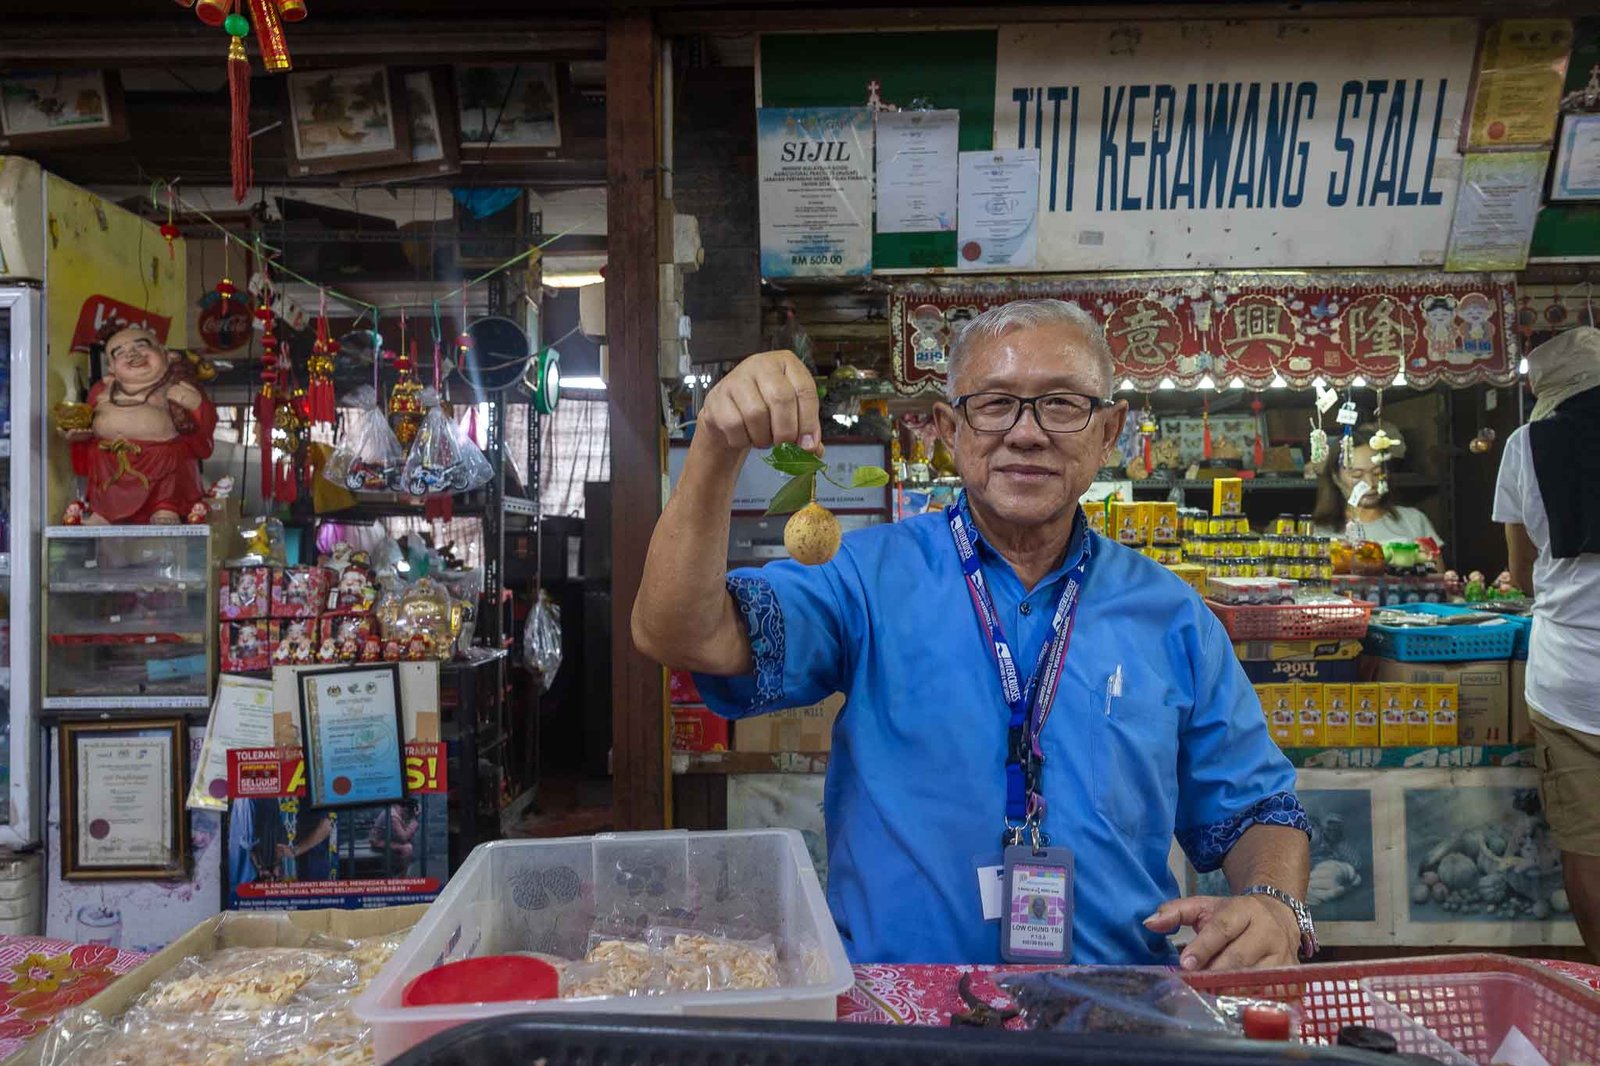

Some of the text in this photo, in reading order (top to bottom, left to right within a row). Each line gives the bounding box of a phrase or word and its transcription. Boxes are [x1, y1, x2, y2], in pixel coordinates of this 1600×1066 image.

[780, 141, 850, 162] SIJIL
[1096, 82, 1317, 211] KERAWANG
[1328, 78, 1448, 207] STALL
[791, 254, 843, 265] RM 500.00
[1003, 657, 1021, 702] INTERCRUISES
